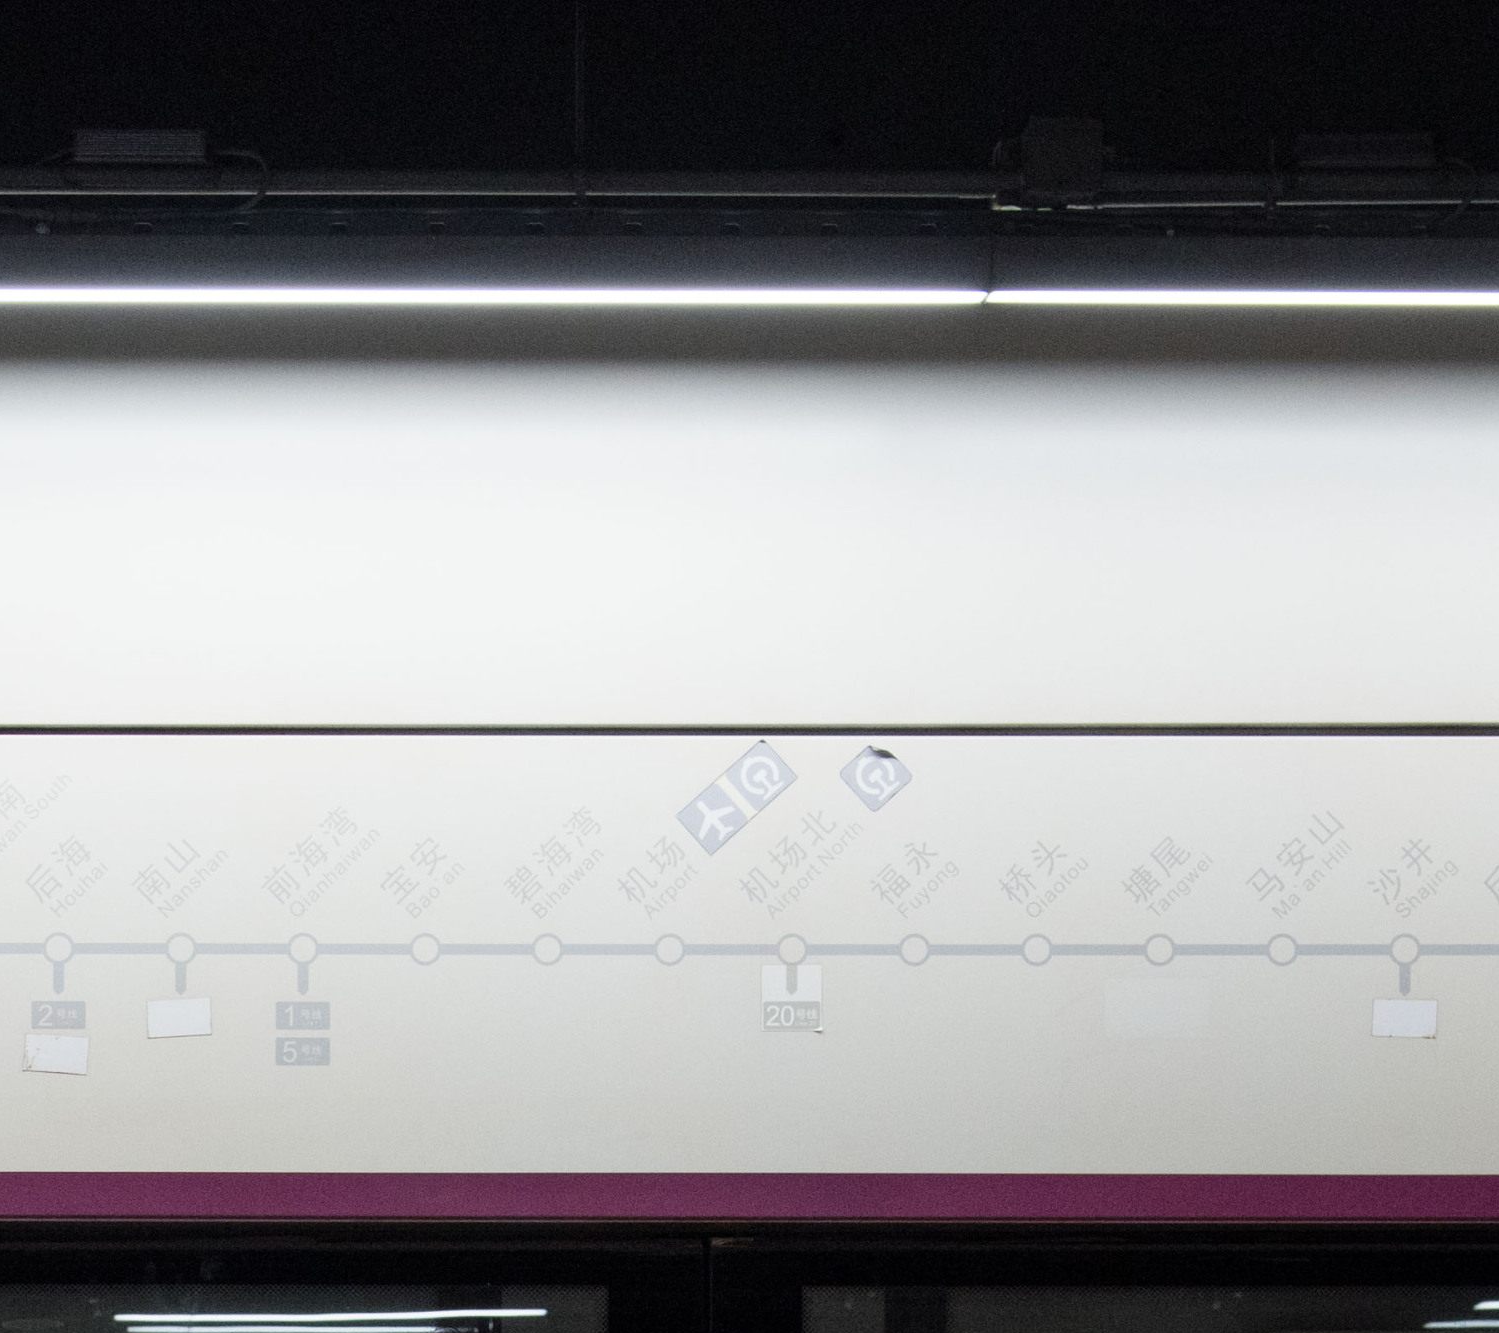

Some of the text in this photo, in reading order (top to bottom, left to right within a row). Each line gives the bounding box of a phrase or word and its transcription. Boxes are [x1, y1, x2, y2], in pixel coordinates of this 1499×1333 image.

[24, 834, 93, 904] 后海
[130, 837, 202, 906] 南山
[157, 845, 231, 919] Nanshan
[261, 806, 360, 906] 前海湾
[288, 824, 382, 919] Qianhaiwan
[379, 837, 448, 905] 宝安
[503, 806, 604, 905] 碧海湾
[530, 846, 605, 920] Bihaiwan
[616, 835, 687, 905] 机场
[738, 809, 838, 905] 机场北
[765, 819, 866, 920] Airport North
[869, 839, 939, 906] 福永
[895, 857, 962, 920] Fuyong
[998, 837, 1068, 906] 桥头
[1025, 855, 1091, 919] Qiaotou
[1121, 836, 1192, 905] 塘尾
[1145, 853, 1216, 919] Tangwei
[1245, 810, 1346, 901] 马安山
[1320, 838, 1354, 873] Hill
[1367, 837, 1434, 906] 沙井
[1394, 857, 1460, 919] Shajing
[643, 863, 701, 920] Airport
